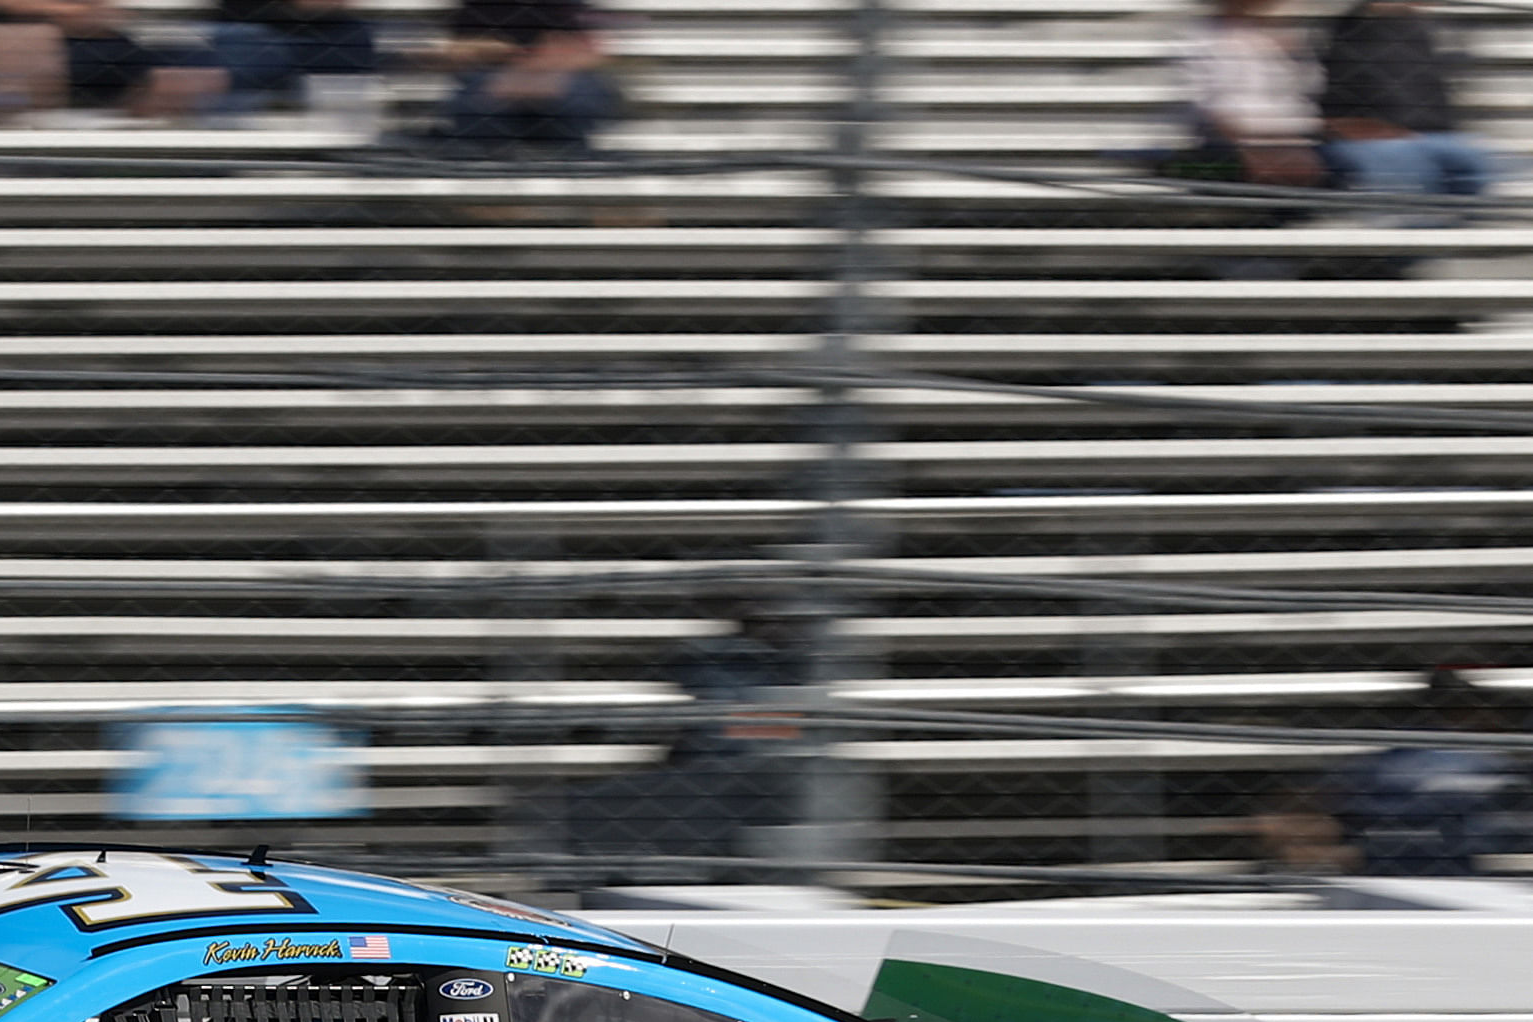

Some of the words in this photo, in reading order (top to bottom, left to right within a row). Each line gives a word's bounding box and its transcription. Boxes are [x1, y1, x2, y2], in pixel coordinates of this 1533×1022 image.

[203, 940, 259, 965] Kevin
[261, 936, 343, 960] Harvick
[447, 979, 487, 998] Ford
